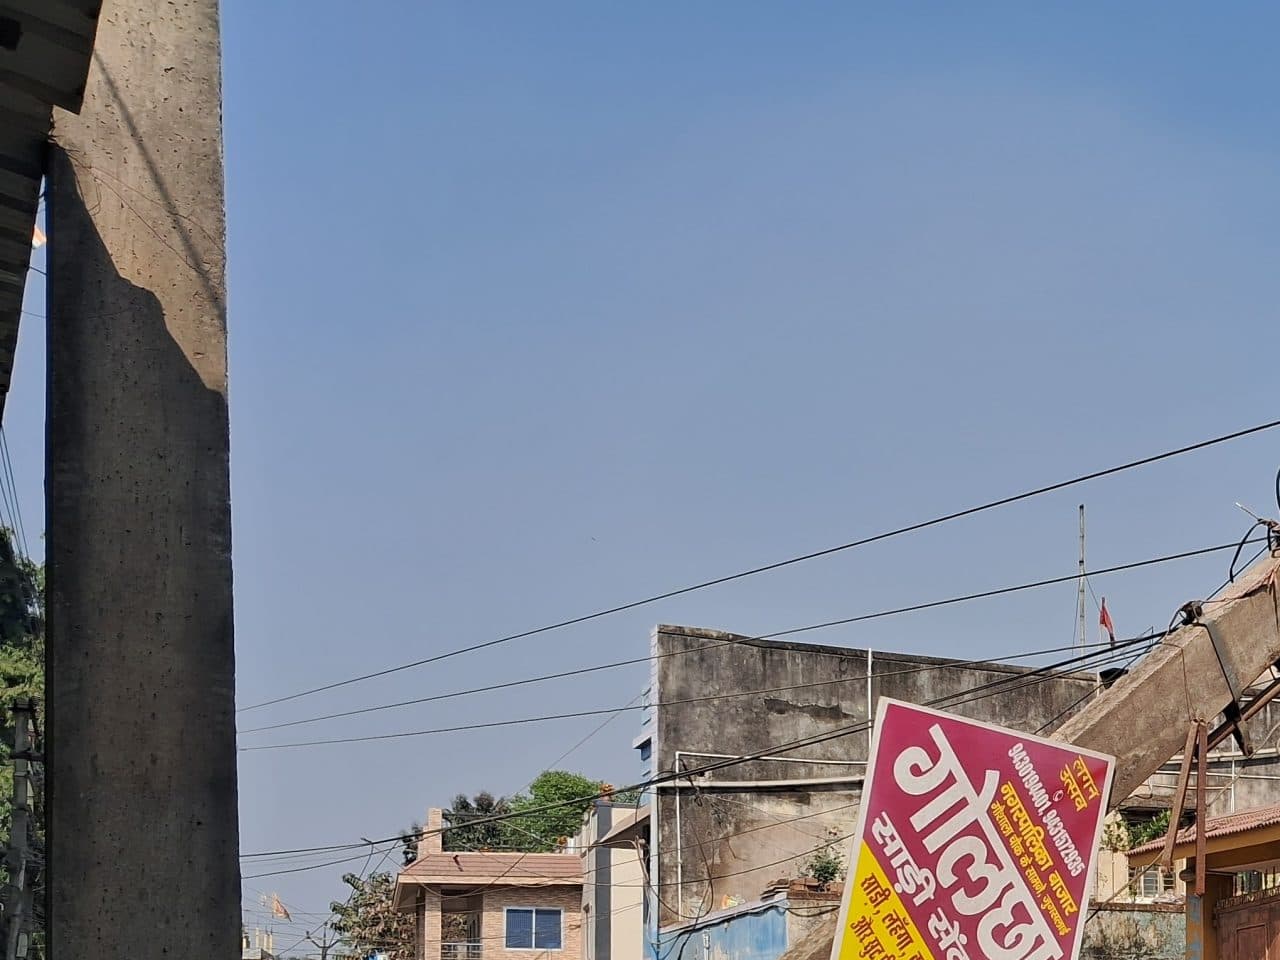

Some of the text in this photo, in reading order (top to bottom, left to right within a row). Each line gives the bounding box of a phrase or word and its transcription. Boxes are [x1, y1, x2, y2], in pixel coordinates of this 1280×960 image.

[1060, 763, 1088, 811] उत्सव
[1073, 756, 1100, 800] लगन
[871, 811, 937, 907] साड़ी
[1000, 781, 1078, 916] नगरपालिका बाजार
[1019, 854, 1032, 867] के
[1043, 808, 1085, 876] 9431572935
[850, 915, 874, 944] और
